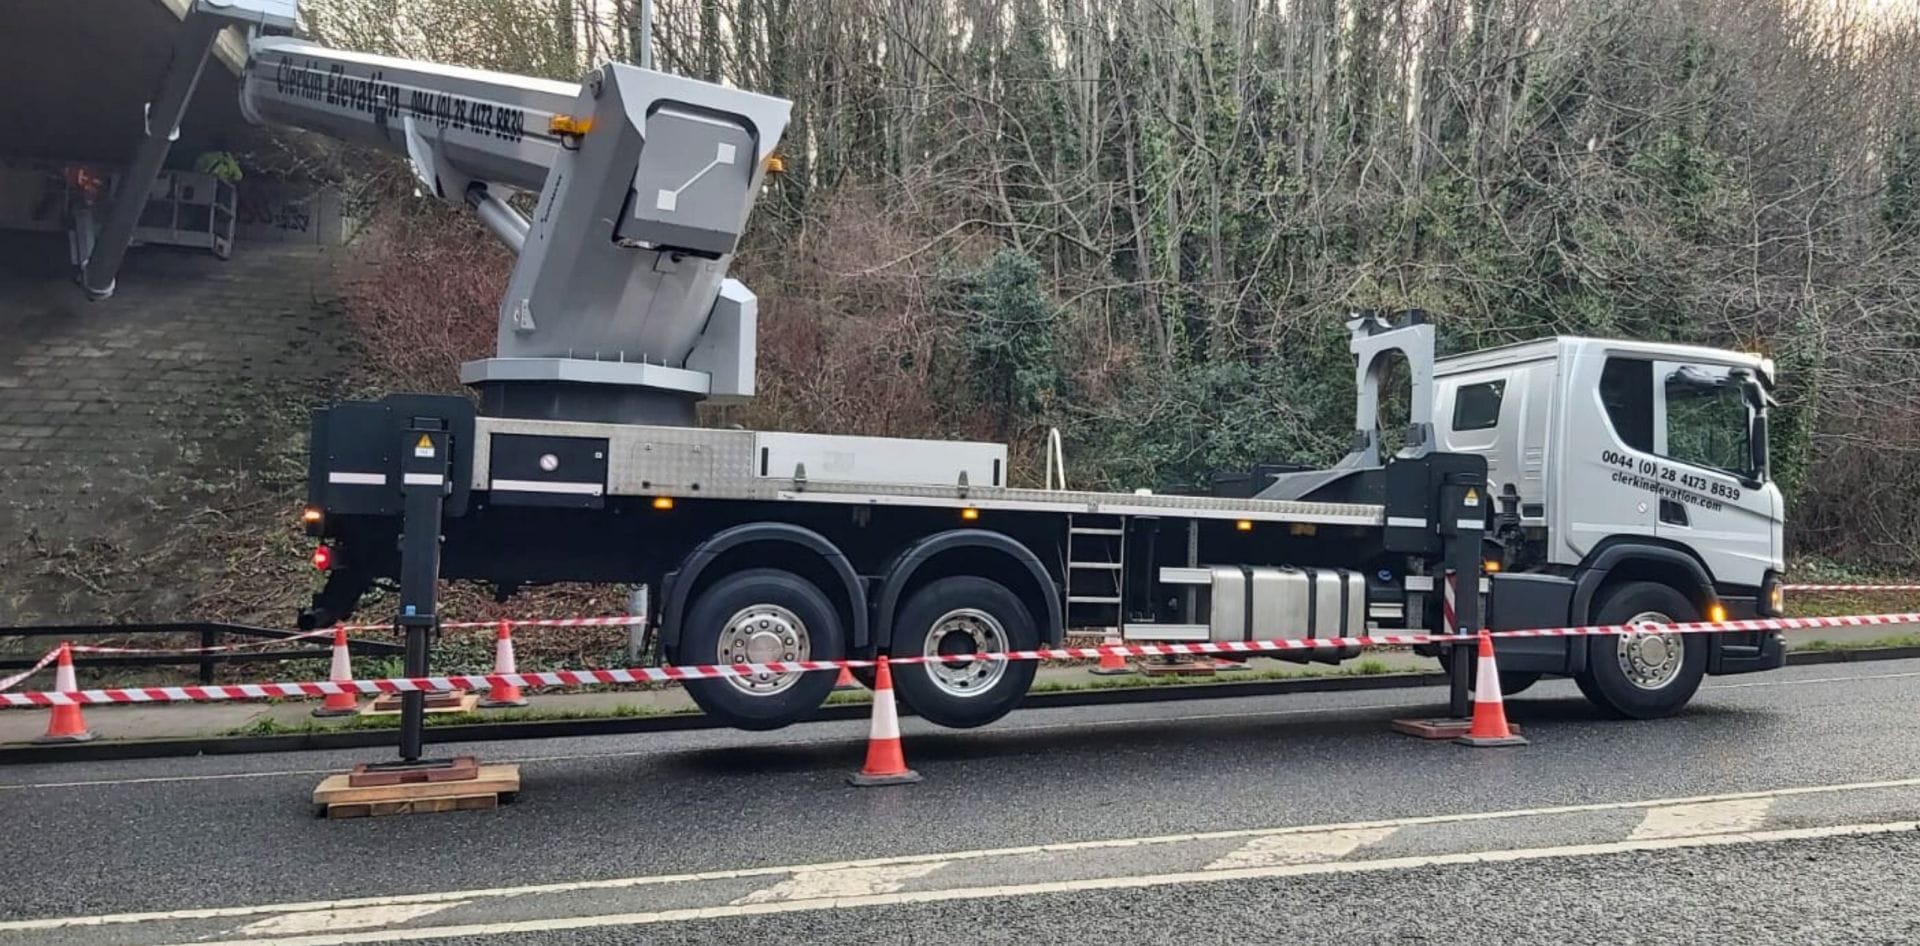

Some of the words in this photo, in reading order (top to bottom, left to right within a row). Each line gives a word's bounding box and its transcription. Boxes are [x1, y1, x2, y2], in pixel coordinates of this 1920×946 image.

[277, 56, 322, 101] Clerkin
[327, 64, 400, 118] Elevation
[411, 91, 434, 122] 0044
[436, 96, 451, 130] (0)
[452, 99, 467, 130] 28
[469, 102, 493, 136] 4173
[496, 107, 524, 143] 8839
[1602, 450, 1633, 468] 0044
[1639, 459, 1657, 477] (0)
[1661, 467, 1677, 482] 28
[1680, 474, 1707, 491] 4173
[1710, 482, 1740, 501] 8839
[1611, 472, 1722, 512] clerkinelevation.com
